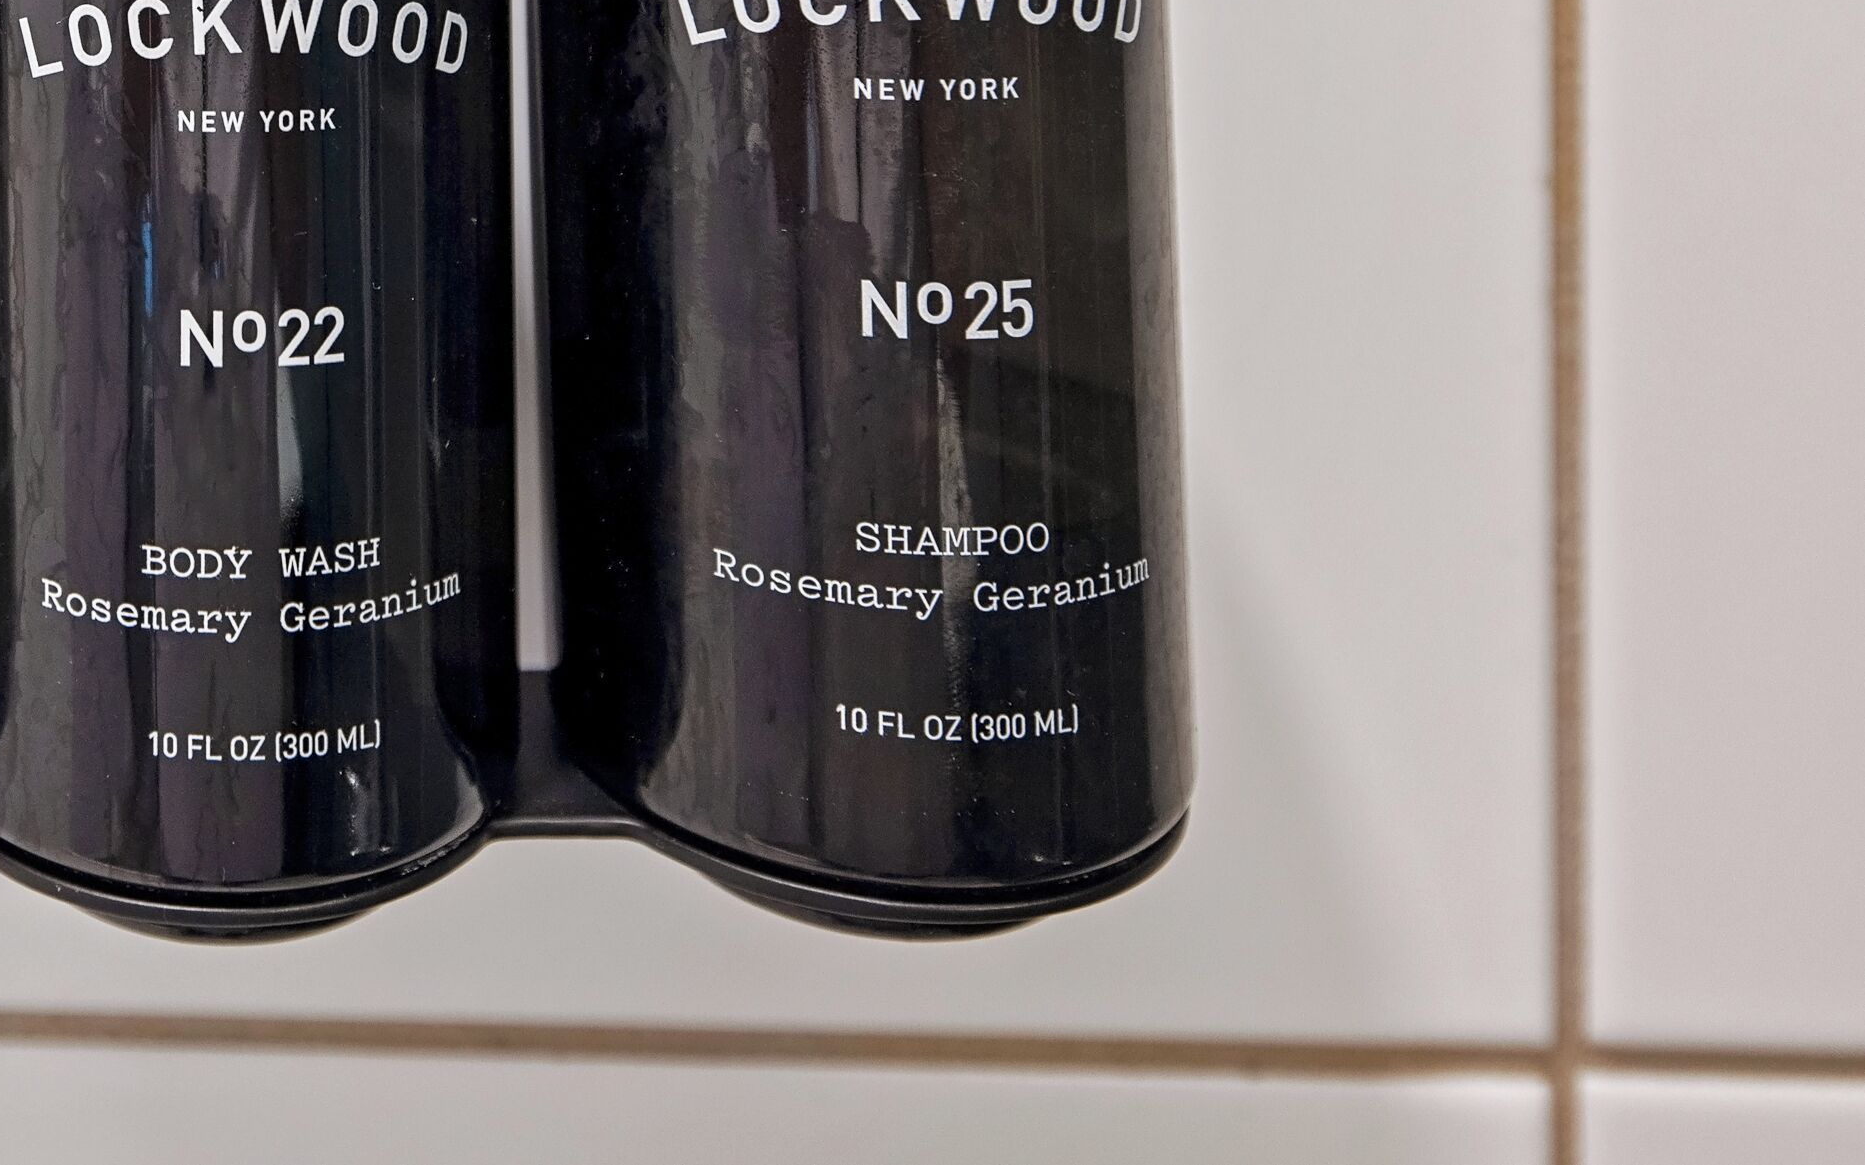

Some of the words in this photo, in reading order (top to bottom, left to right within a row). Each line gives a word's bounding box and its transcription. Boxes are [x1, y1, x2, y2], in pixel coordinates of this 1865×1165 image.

[853, 77, 925, 101] NEW
[939, 76, 1019, 101] YORK
[177, 109, 245, 133] NEW
[259, 108, 336, 133] YORK
[855, 521, 1050, 556] SHAMPOO
[141, 544, 253, 580] BODY
[278, 537, 381, 578] WASH
[712, 547, 944, 621] Rosemary
[973, 558, 1150, 612] Geranium
[41, 577, 252, 644] Rosemary
[279, 573, 461, 633] Geranium
[835, 704, 868, 733] 10
[878, 710, 916, 739] FL
[923, 714, 962, 741] OZ
[148, 730, 178, 759] 10
[187, 733, 223, 762] FL
[229, 735, 266, 762] OZ
